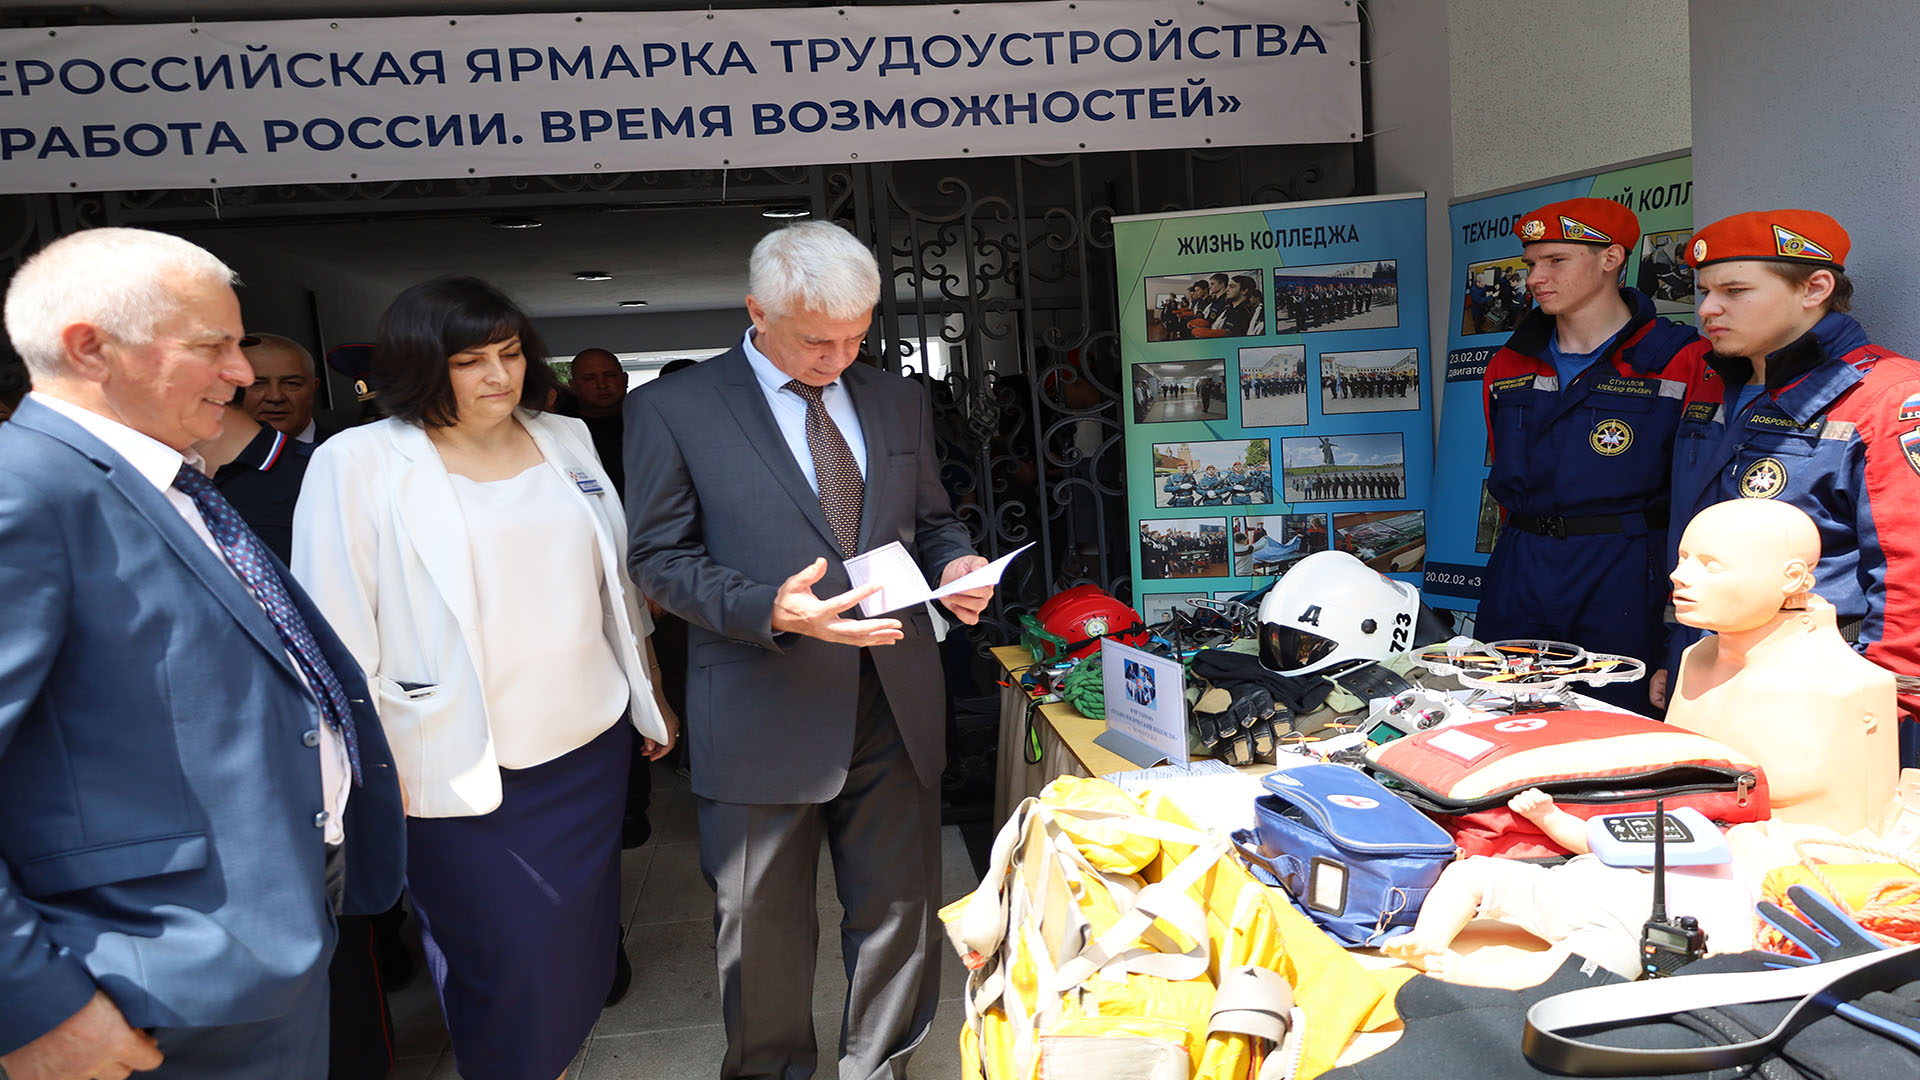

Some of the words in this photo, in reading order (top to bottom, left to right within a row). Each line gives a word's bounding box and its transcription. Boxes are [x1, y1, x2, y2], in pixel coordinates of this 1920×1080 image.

[466, 41, 757, 83] ЯРМАРКА
[770, 19, 1327, 77] ТРУДОУСТРОЙСТВА
[0, 121, 248, 160] РАБОТА
[264, 113, 523, 152] РОССИИ.
[541, 105, 732, 143] ВРЕМЯ
[752, 78, 1242, 135] ВОЗМОЖНОСТЕЙ»
[1177, 233, 1244, 256] ЖИЗНЬ
[1251, 224, 1360, 250] КОЛЛЕДЖА
[1449, 350, 1489, 364] 23.02.07
[1425, 571, 1466, 586] 20.02.02
[1389, 612, 1412, 653] 723
